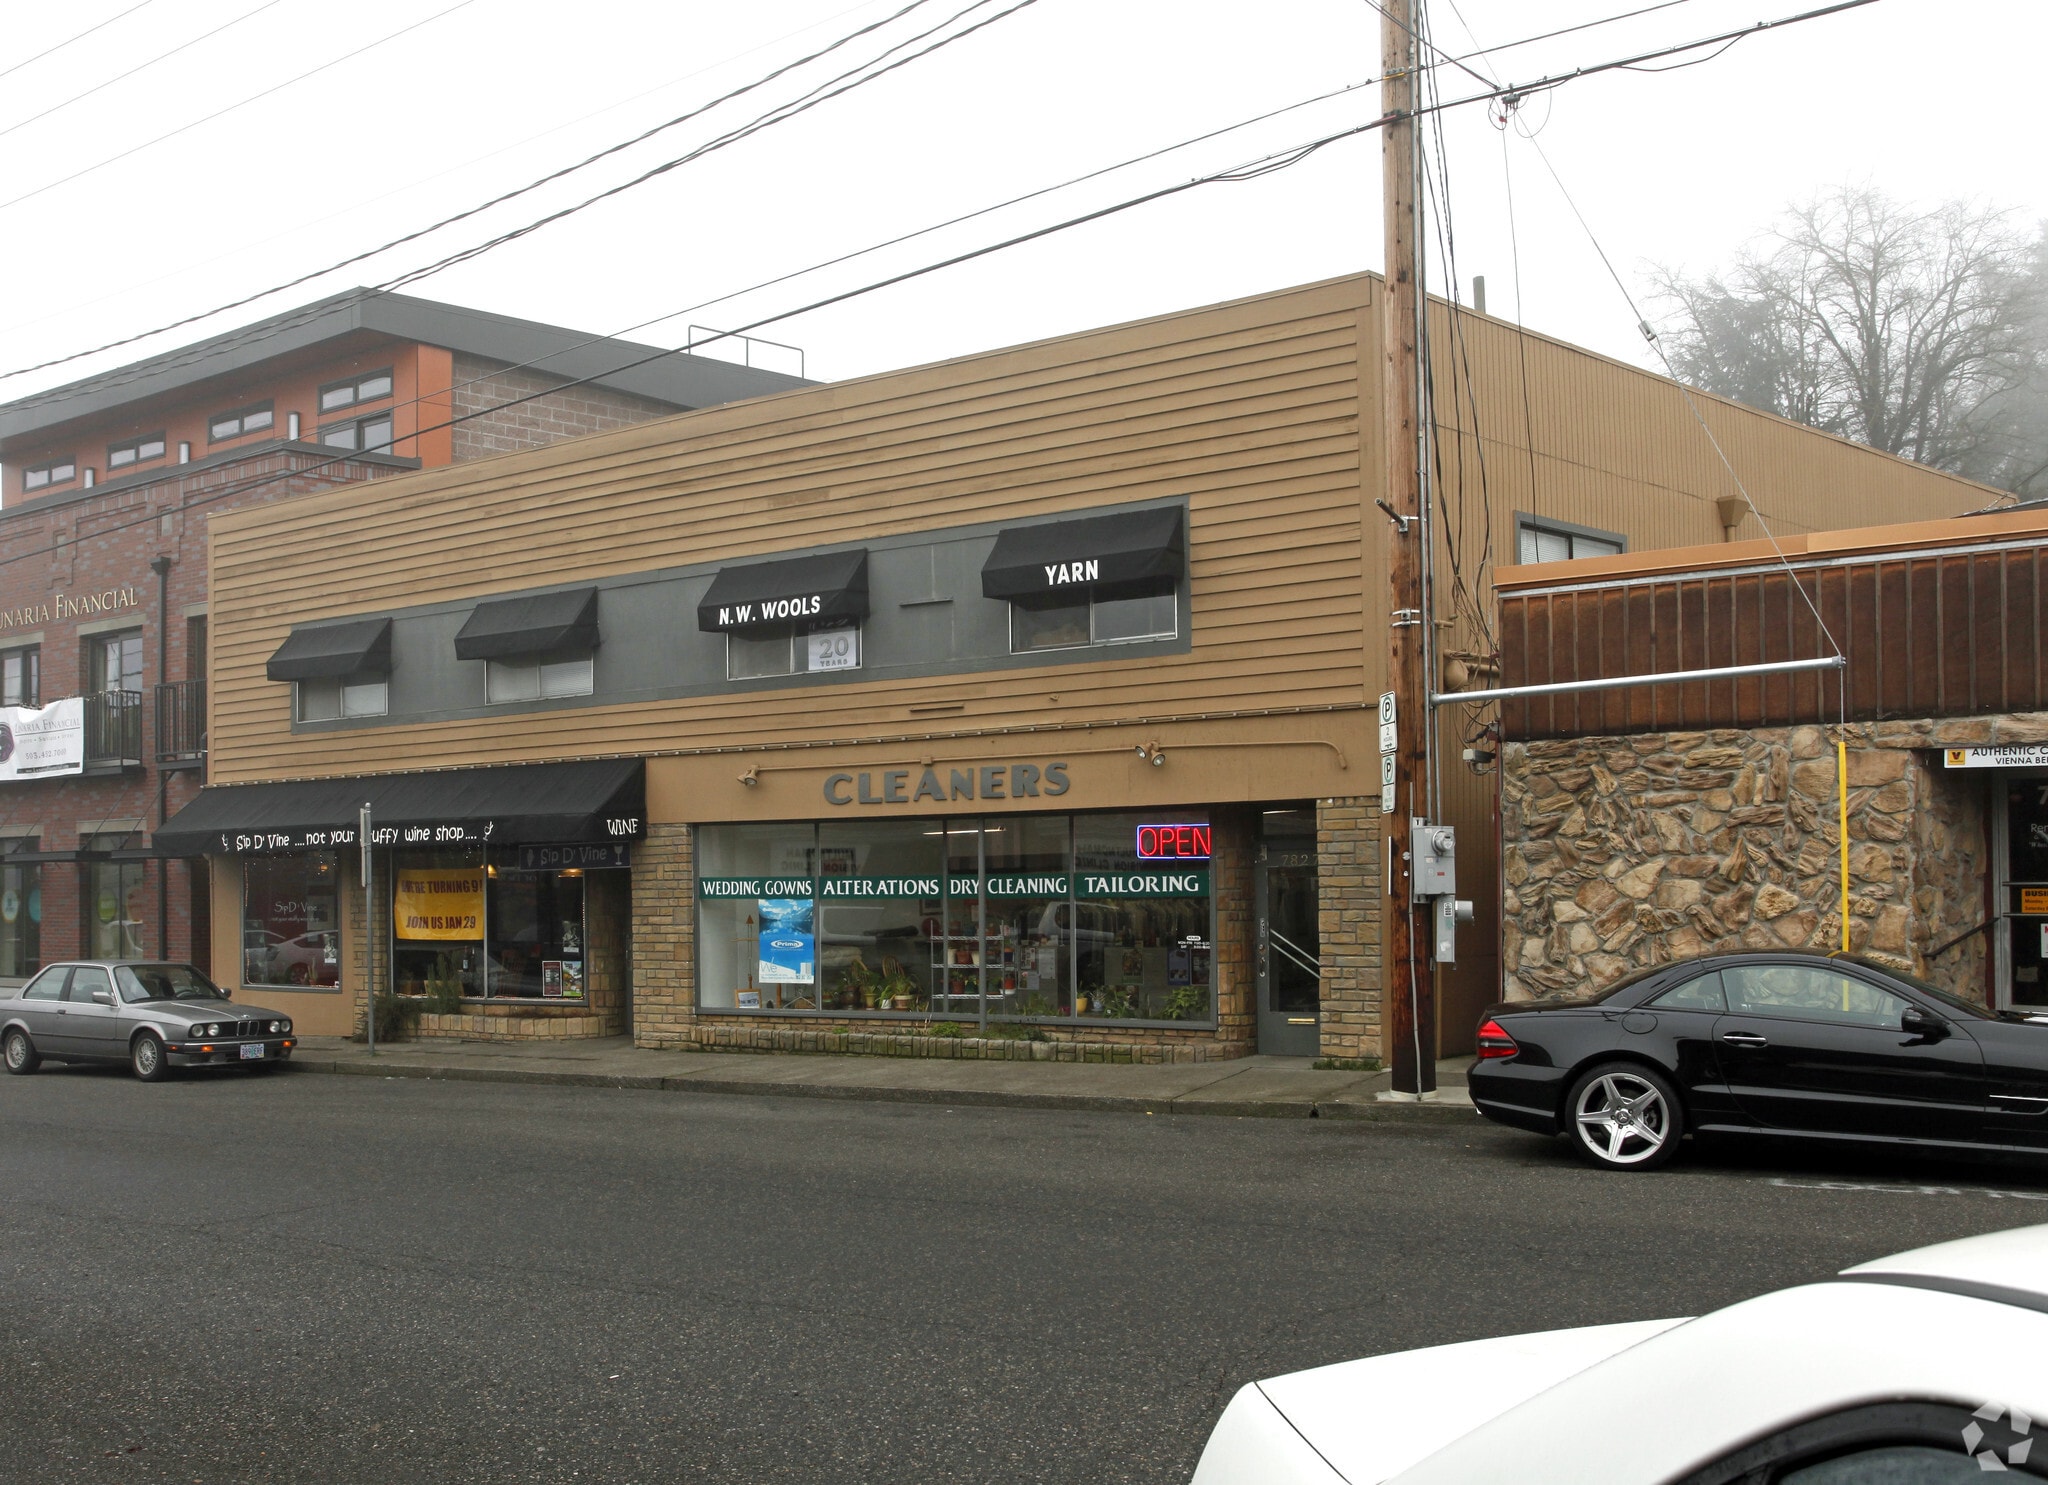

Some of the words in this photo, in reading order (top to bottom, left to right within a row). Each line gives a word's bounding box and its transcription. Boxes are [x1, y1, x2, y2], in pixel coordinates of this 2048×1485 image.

[1045, 560, 1098, 585] YARN
[56, 588, 138, 618] FINANCIAL
[719, 605, 756, 625] N.W.
[762, 595, 821, 620] WOOLS
[819, 636, 849, 659] 20
[820, 659, 848, 667] YEARS
[1972, 747, 2036, 756] AUTHENTIC
[1995, 757, 2033, 765] VIENNA
[824, 762, 1070, 805] CLEANERS
[607, 818, 639, 836] WINE
[236, 834, 251, 851] Sip
[268, 833, 290, 849] Vine
[330, 830, 355, 845] your
[405, 826, 431, 842] wine
[1139, 826, 1211, 857] OPEN
[540, 848, 559, 866] Sip
[579, 846, 608, 863] Vine
[428, 880, 470, 893] TURNING
[702, 880, 760, 895] WEDDING
[765, 880, 812, 895] GOWNS
[823, 879, 940, 895] ALTERATIONS
[949, 879, 979, 895] DRY
[987, 878, 1067, 894] CLEANING
[1084, 875, 1199, 893] TAILORING
[406, 916, 428, 929] JOIN
[431, 916, 443, 929] US
[445, 916, 462, 929] JAN
[464, 916, 476, 929] 29
